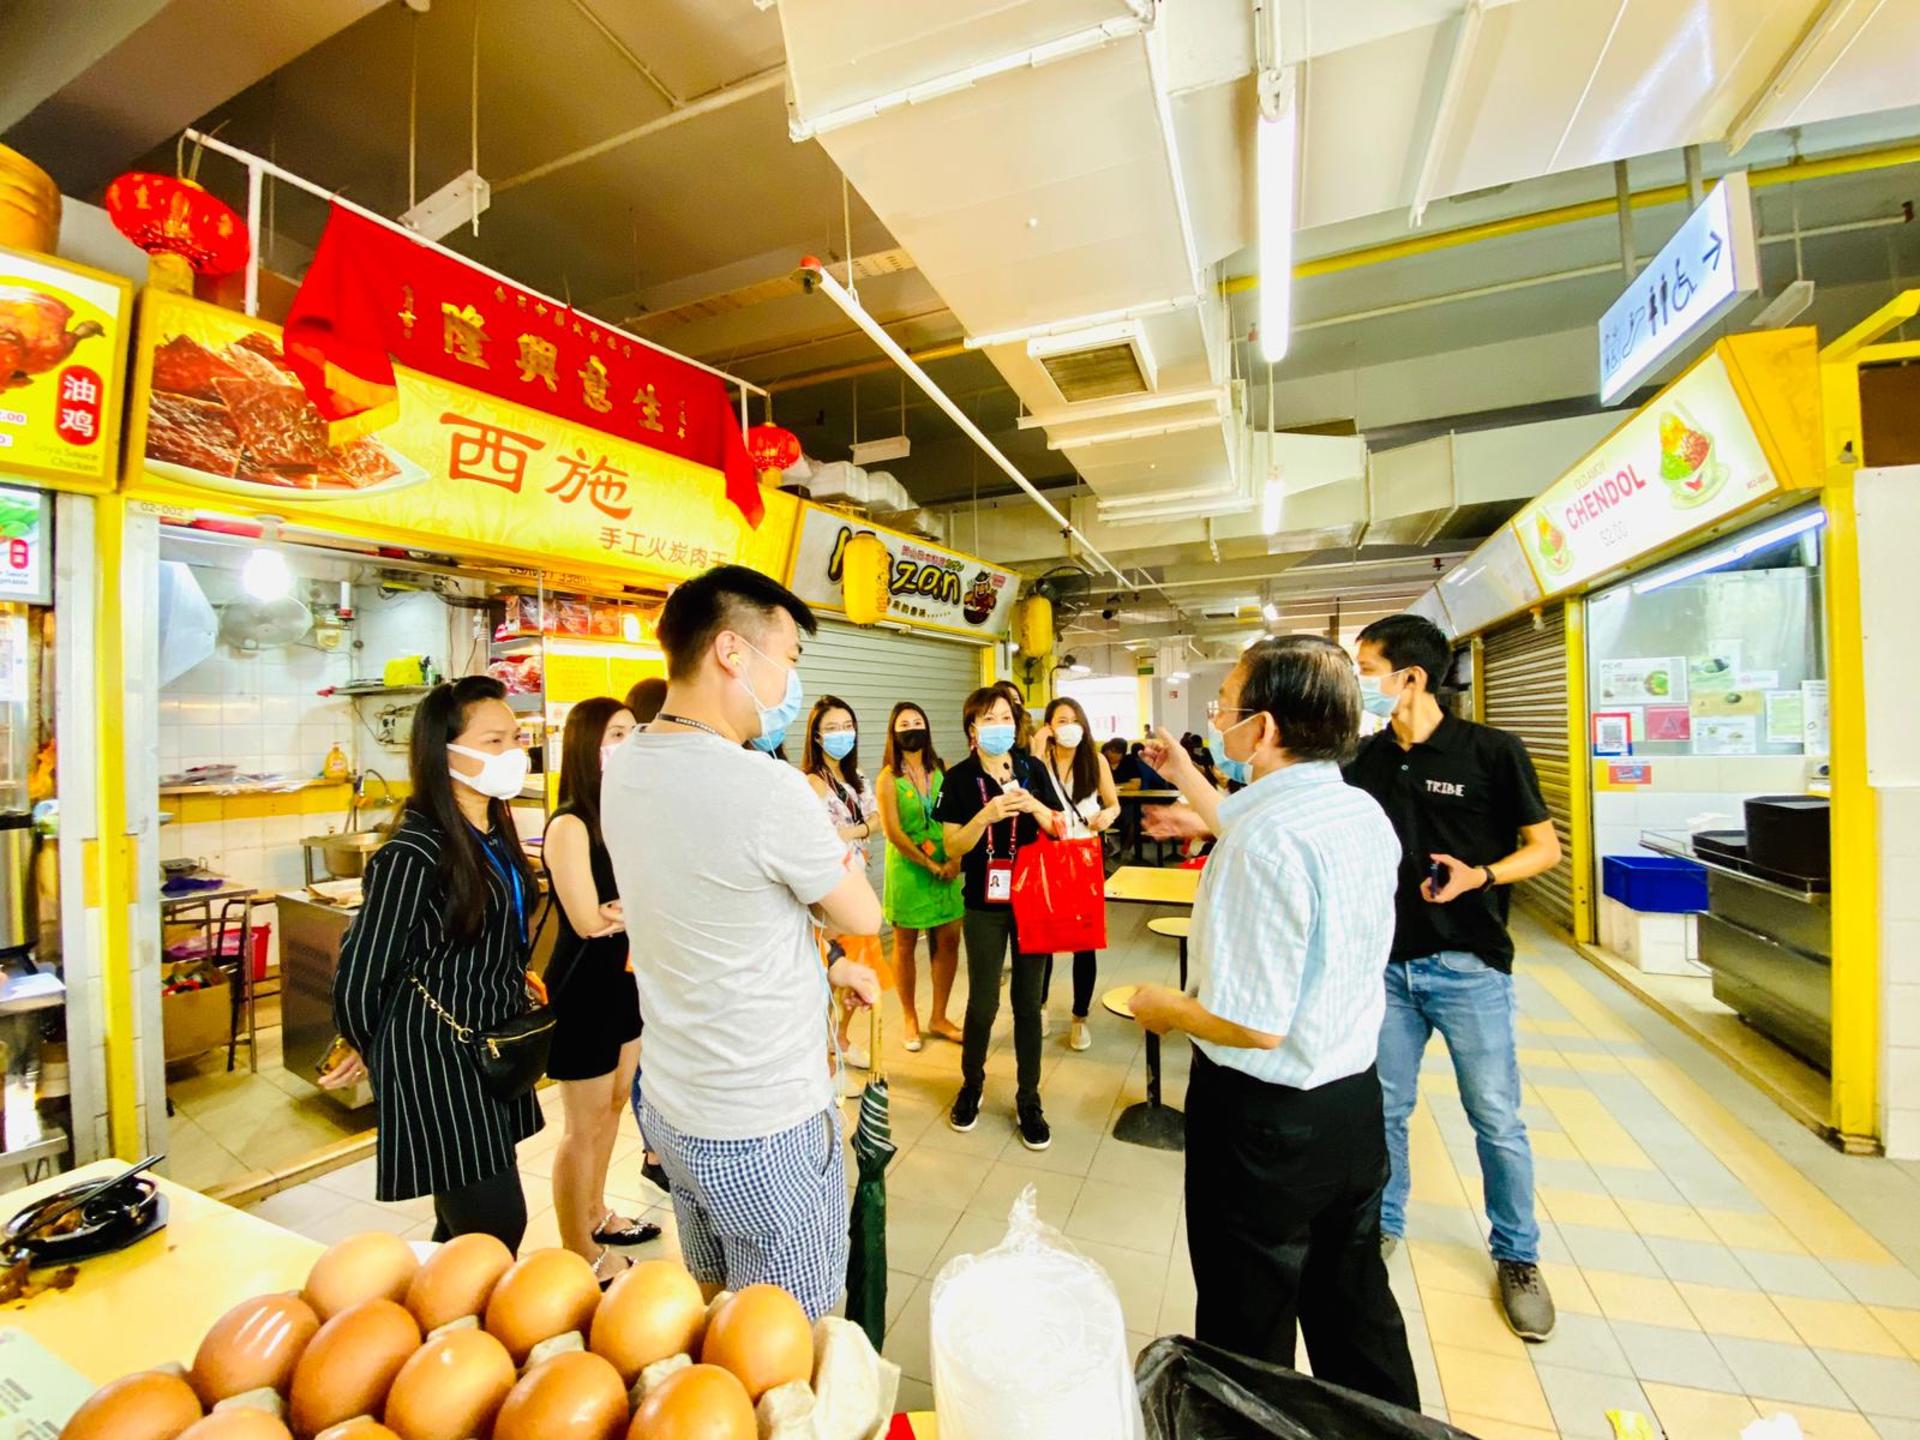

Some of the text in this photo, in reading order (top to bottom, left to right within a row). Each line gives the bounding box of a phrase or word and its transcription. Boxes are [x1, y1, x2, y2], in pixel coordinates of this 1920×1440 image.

[60, 374, 97, 437] 油鸡
[439, 411, 634, 521] 西施
[1565, 463, 1647, 530] CHENDOL
[1425, 779, 1466, 797] TRIBE
